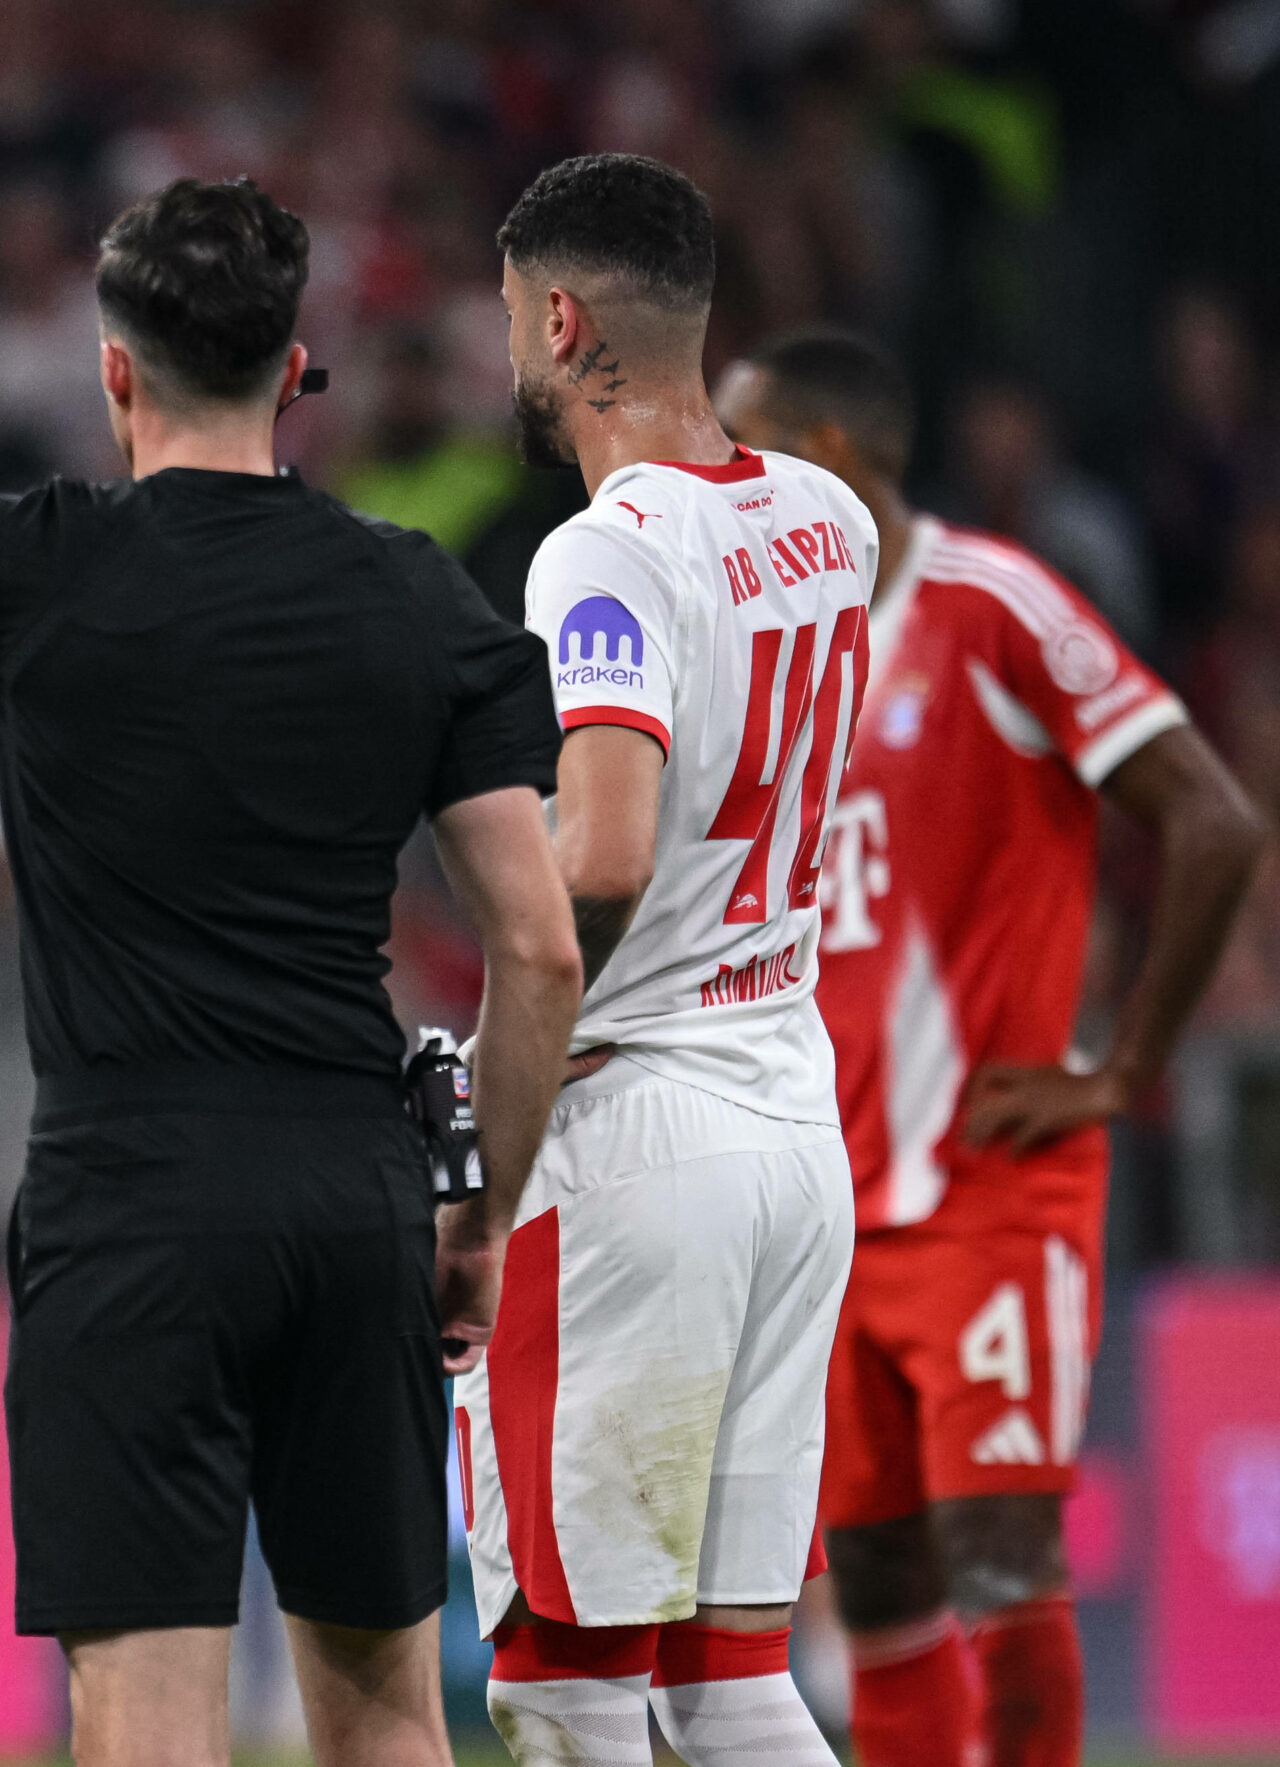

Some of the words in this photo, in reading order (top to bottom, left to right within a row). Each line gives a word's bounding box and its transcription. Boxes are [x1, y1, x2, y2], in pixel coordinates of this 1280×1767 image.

[722, 547, 762, 607] RB
[767, 521, 857, 588] EIPZIG
[557, 666, 644, 689] kraken
[704, 604, 870, 924] 40
[958, 1281, 1032, 1400] 4
